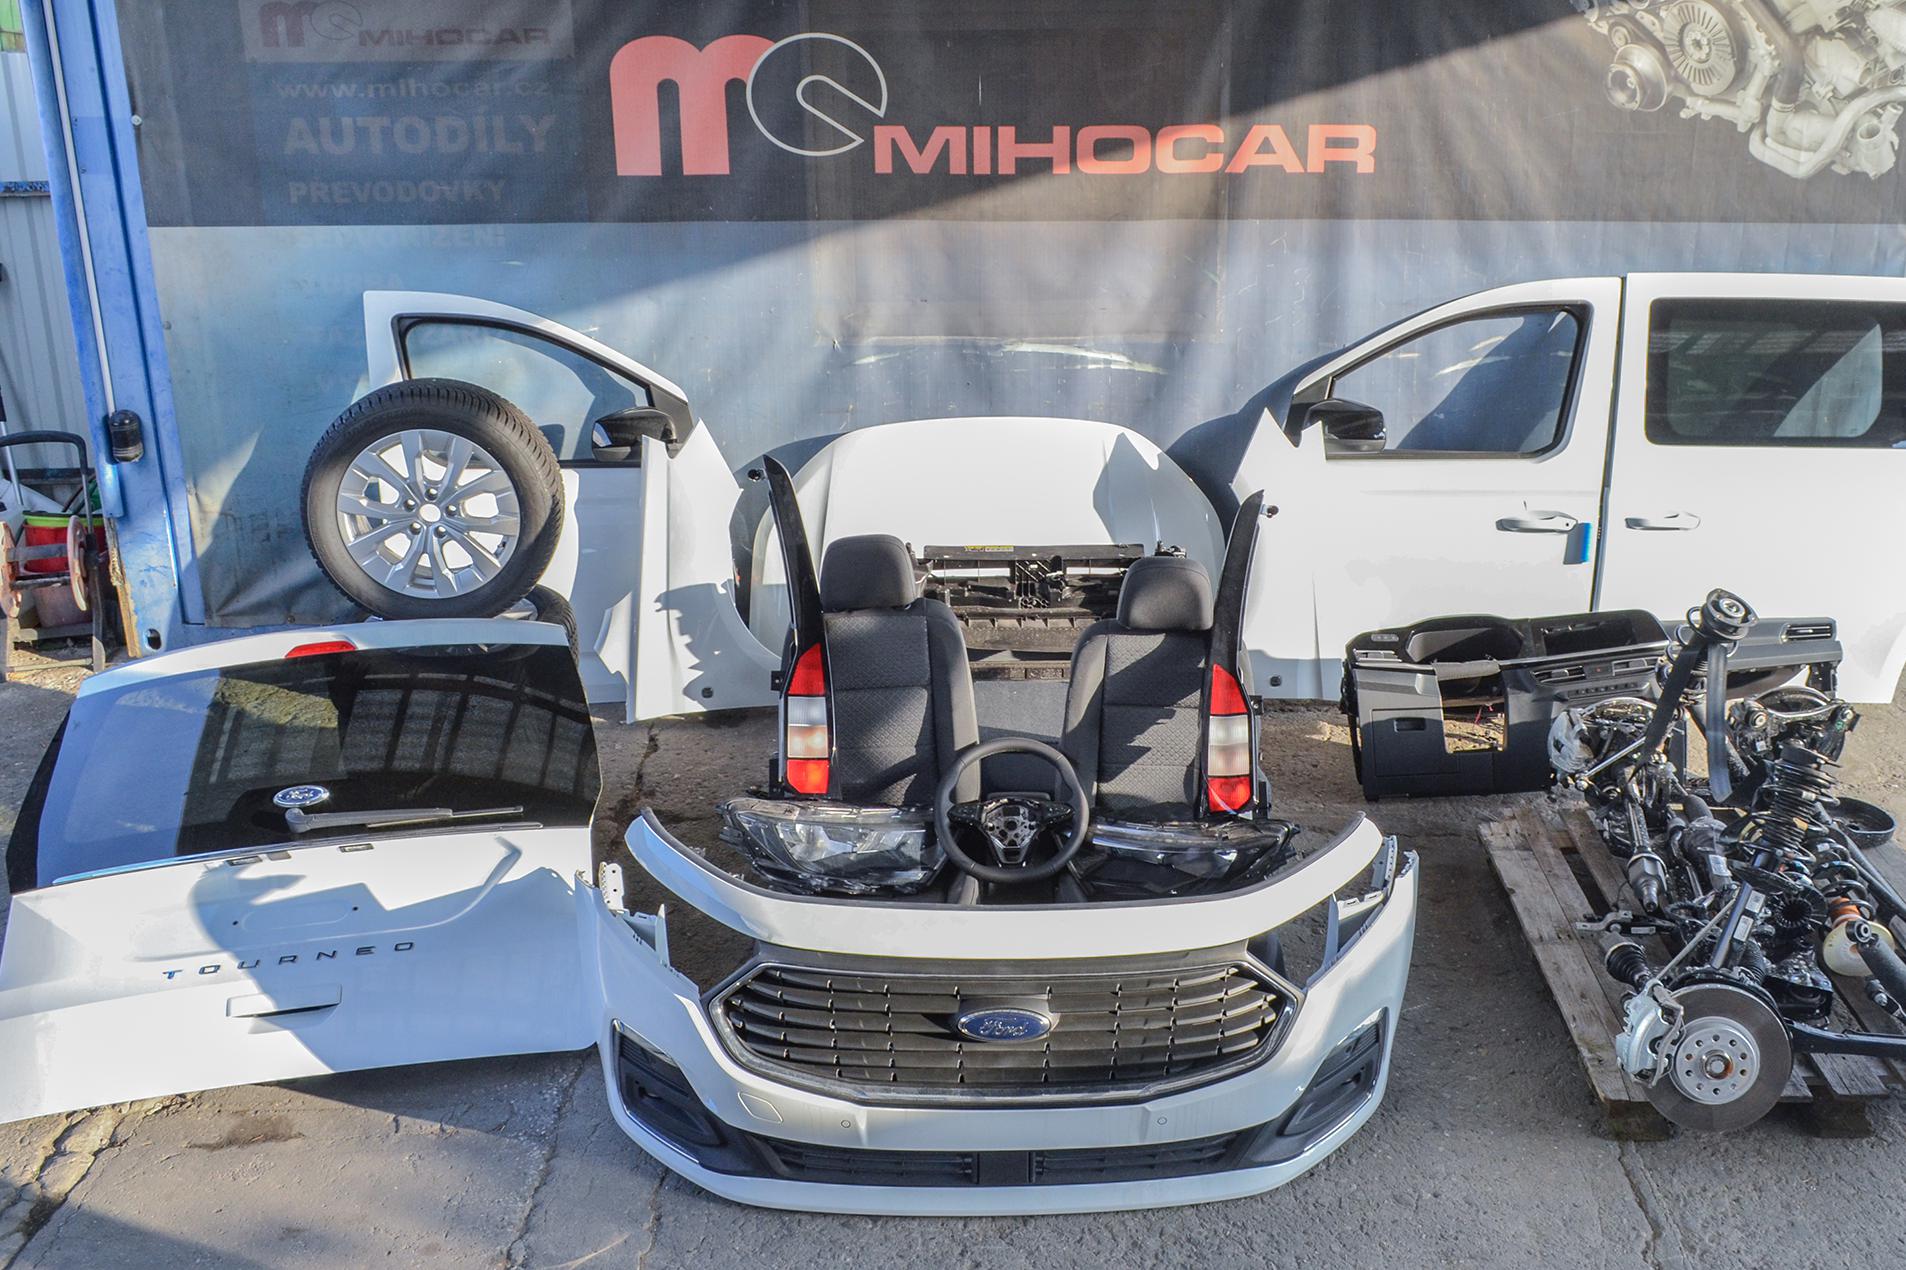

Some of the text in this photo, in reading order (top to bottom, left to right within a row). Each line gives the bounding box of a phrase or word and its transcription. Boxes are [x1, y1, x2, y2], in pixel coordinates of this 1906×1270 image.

[283, 105, 557, 155] AUTODÍLY
[873, 124, 1377, 175] MIHOCAR
[161, 941, 415, 980] TOURNEO
[979, 1018, 1029, 1037] Ford
